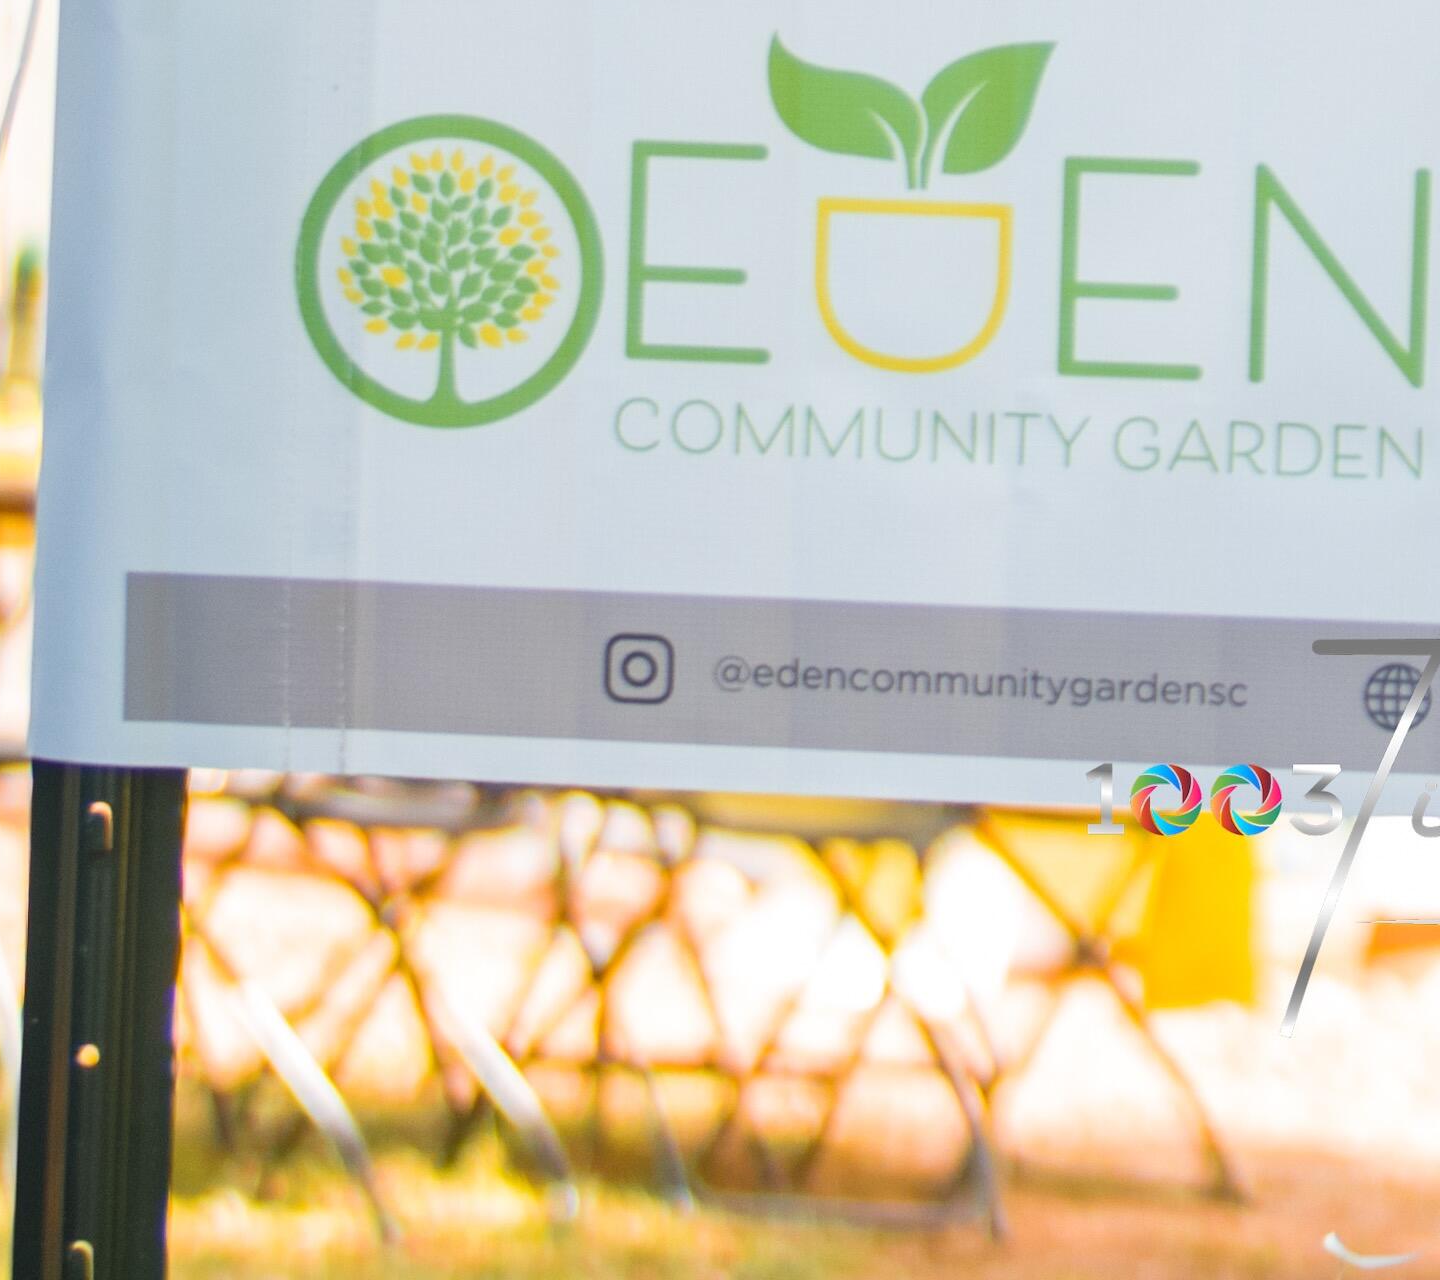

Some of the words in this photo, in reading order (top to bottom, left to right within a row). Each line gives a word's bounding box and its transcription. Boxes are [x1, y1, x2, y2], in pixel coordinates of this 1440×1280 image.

[612, 396, 1092, 469] COMMUNITY
[1111, 415, 1425, 480] GARDEN
[712, 655, 1249, 708] @edencommunitygardensc
